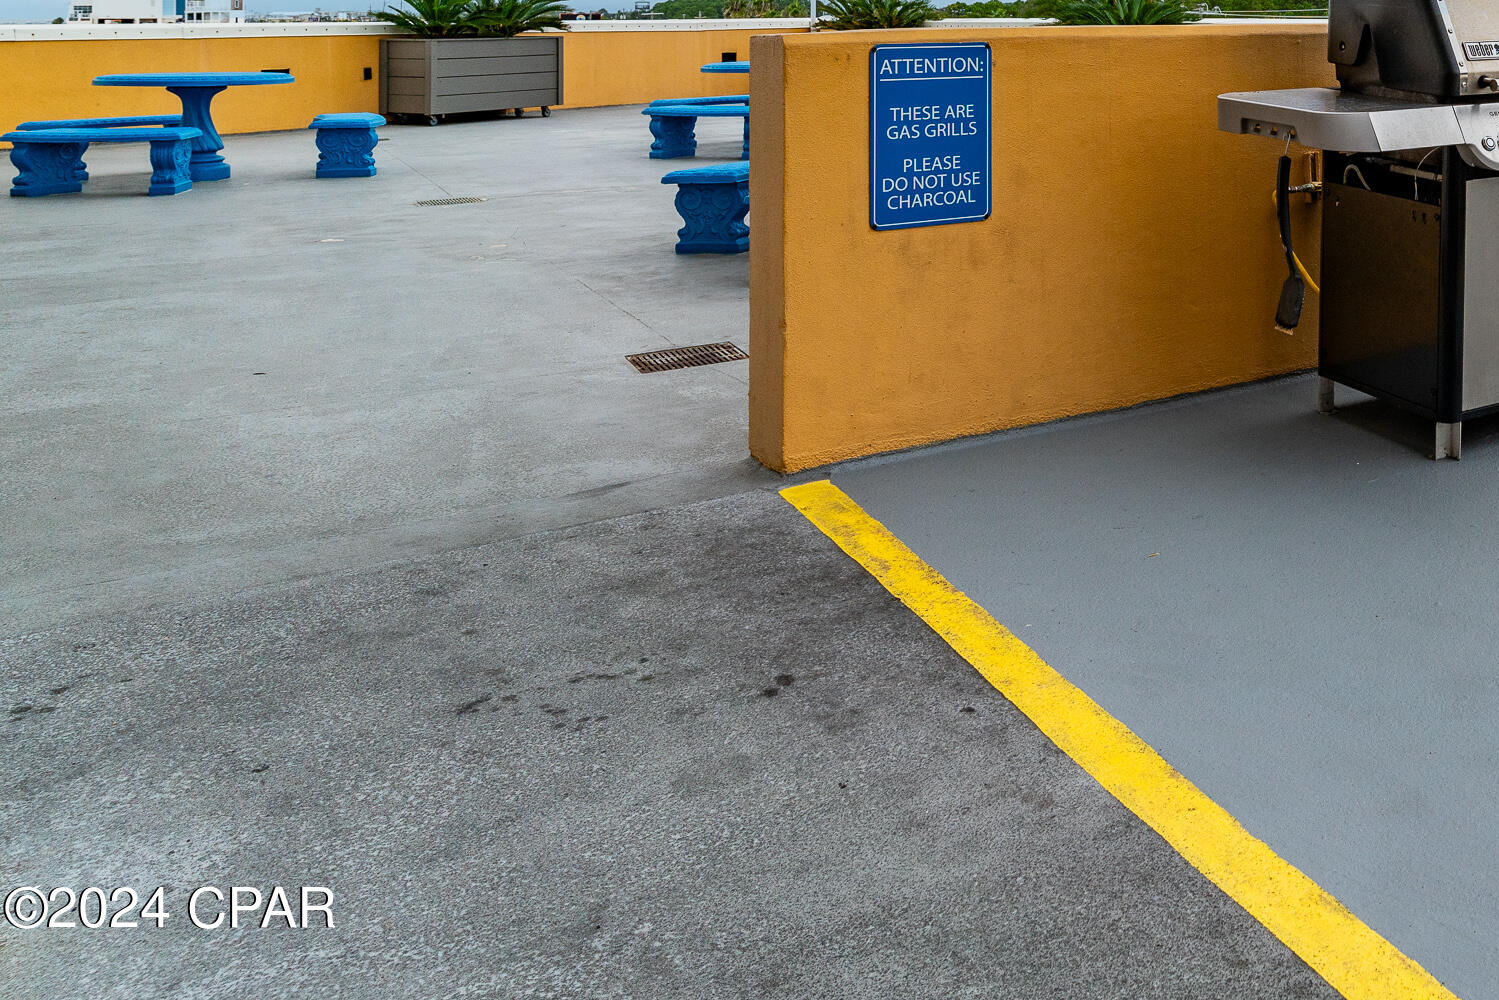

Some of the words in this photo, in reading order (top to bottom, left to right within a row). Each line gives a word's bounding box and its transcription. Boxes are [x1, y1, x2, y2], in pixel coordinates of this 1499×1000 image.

[880, 57, 984, 75] ATTENTION:
[890, 105, 940, 122] THESE
[944, 104, 975, 119] ARE
[886, 124, 920, 140] GAS
[924, 121, 977, 138] GRILLS
[903, 155, 961, 173] PLEASE
[882, 176, 908, 193] DO
[913, 173, 947, 190] NOT
[951, 171, 981, 187] USE
[887, 189, 976, 210] CHARCOAL
